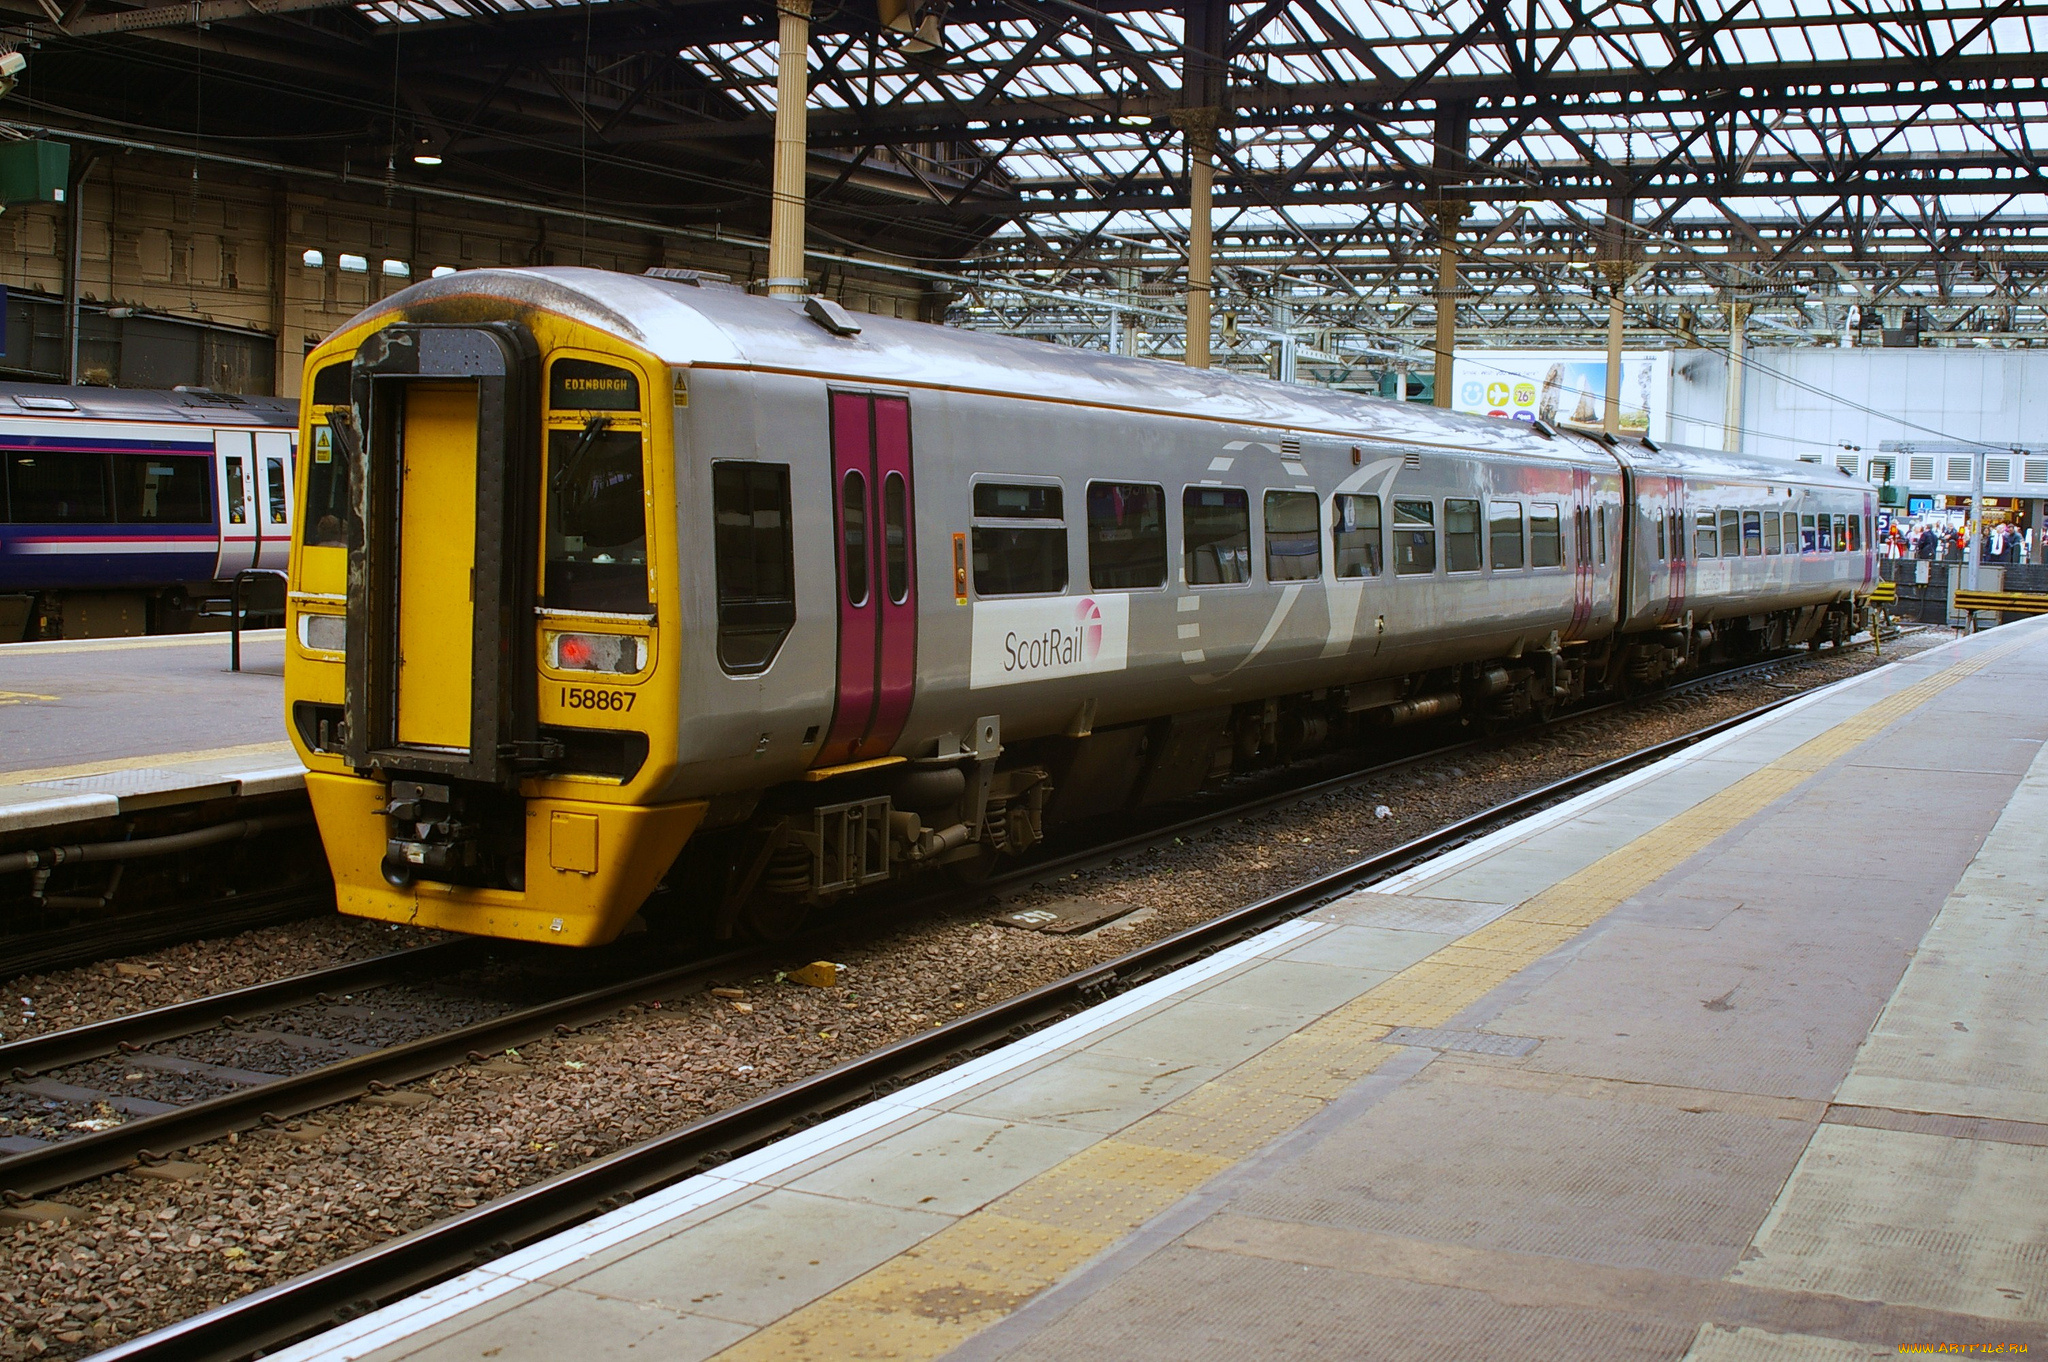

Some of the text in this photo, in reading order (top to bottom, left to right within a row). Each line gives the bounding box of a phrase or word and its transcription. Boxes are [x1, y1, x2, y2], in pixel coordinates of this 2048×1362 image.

[564, 378, 628, 391] EDINBURGH
[1003, 625, 1084, 672] ScotRail
[560, 687, 637, 712] 158867
